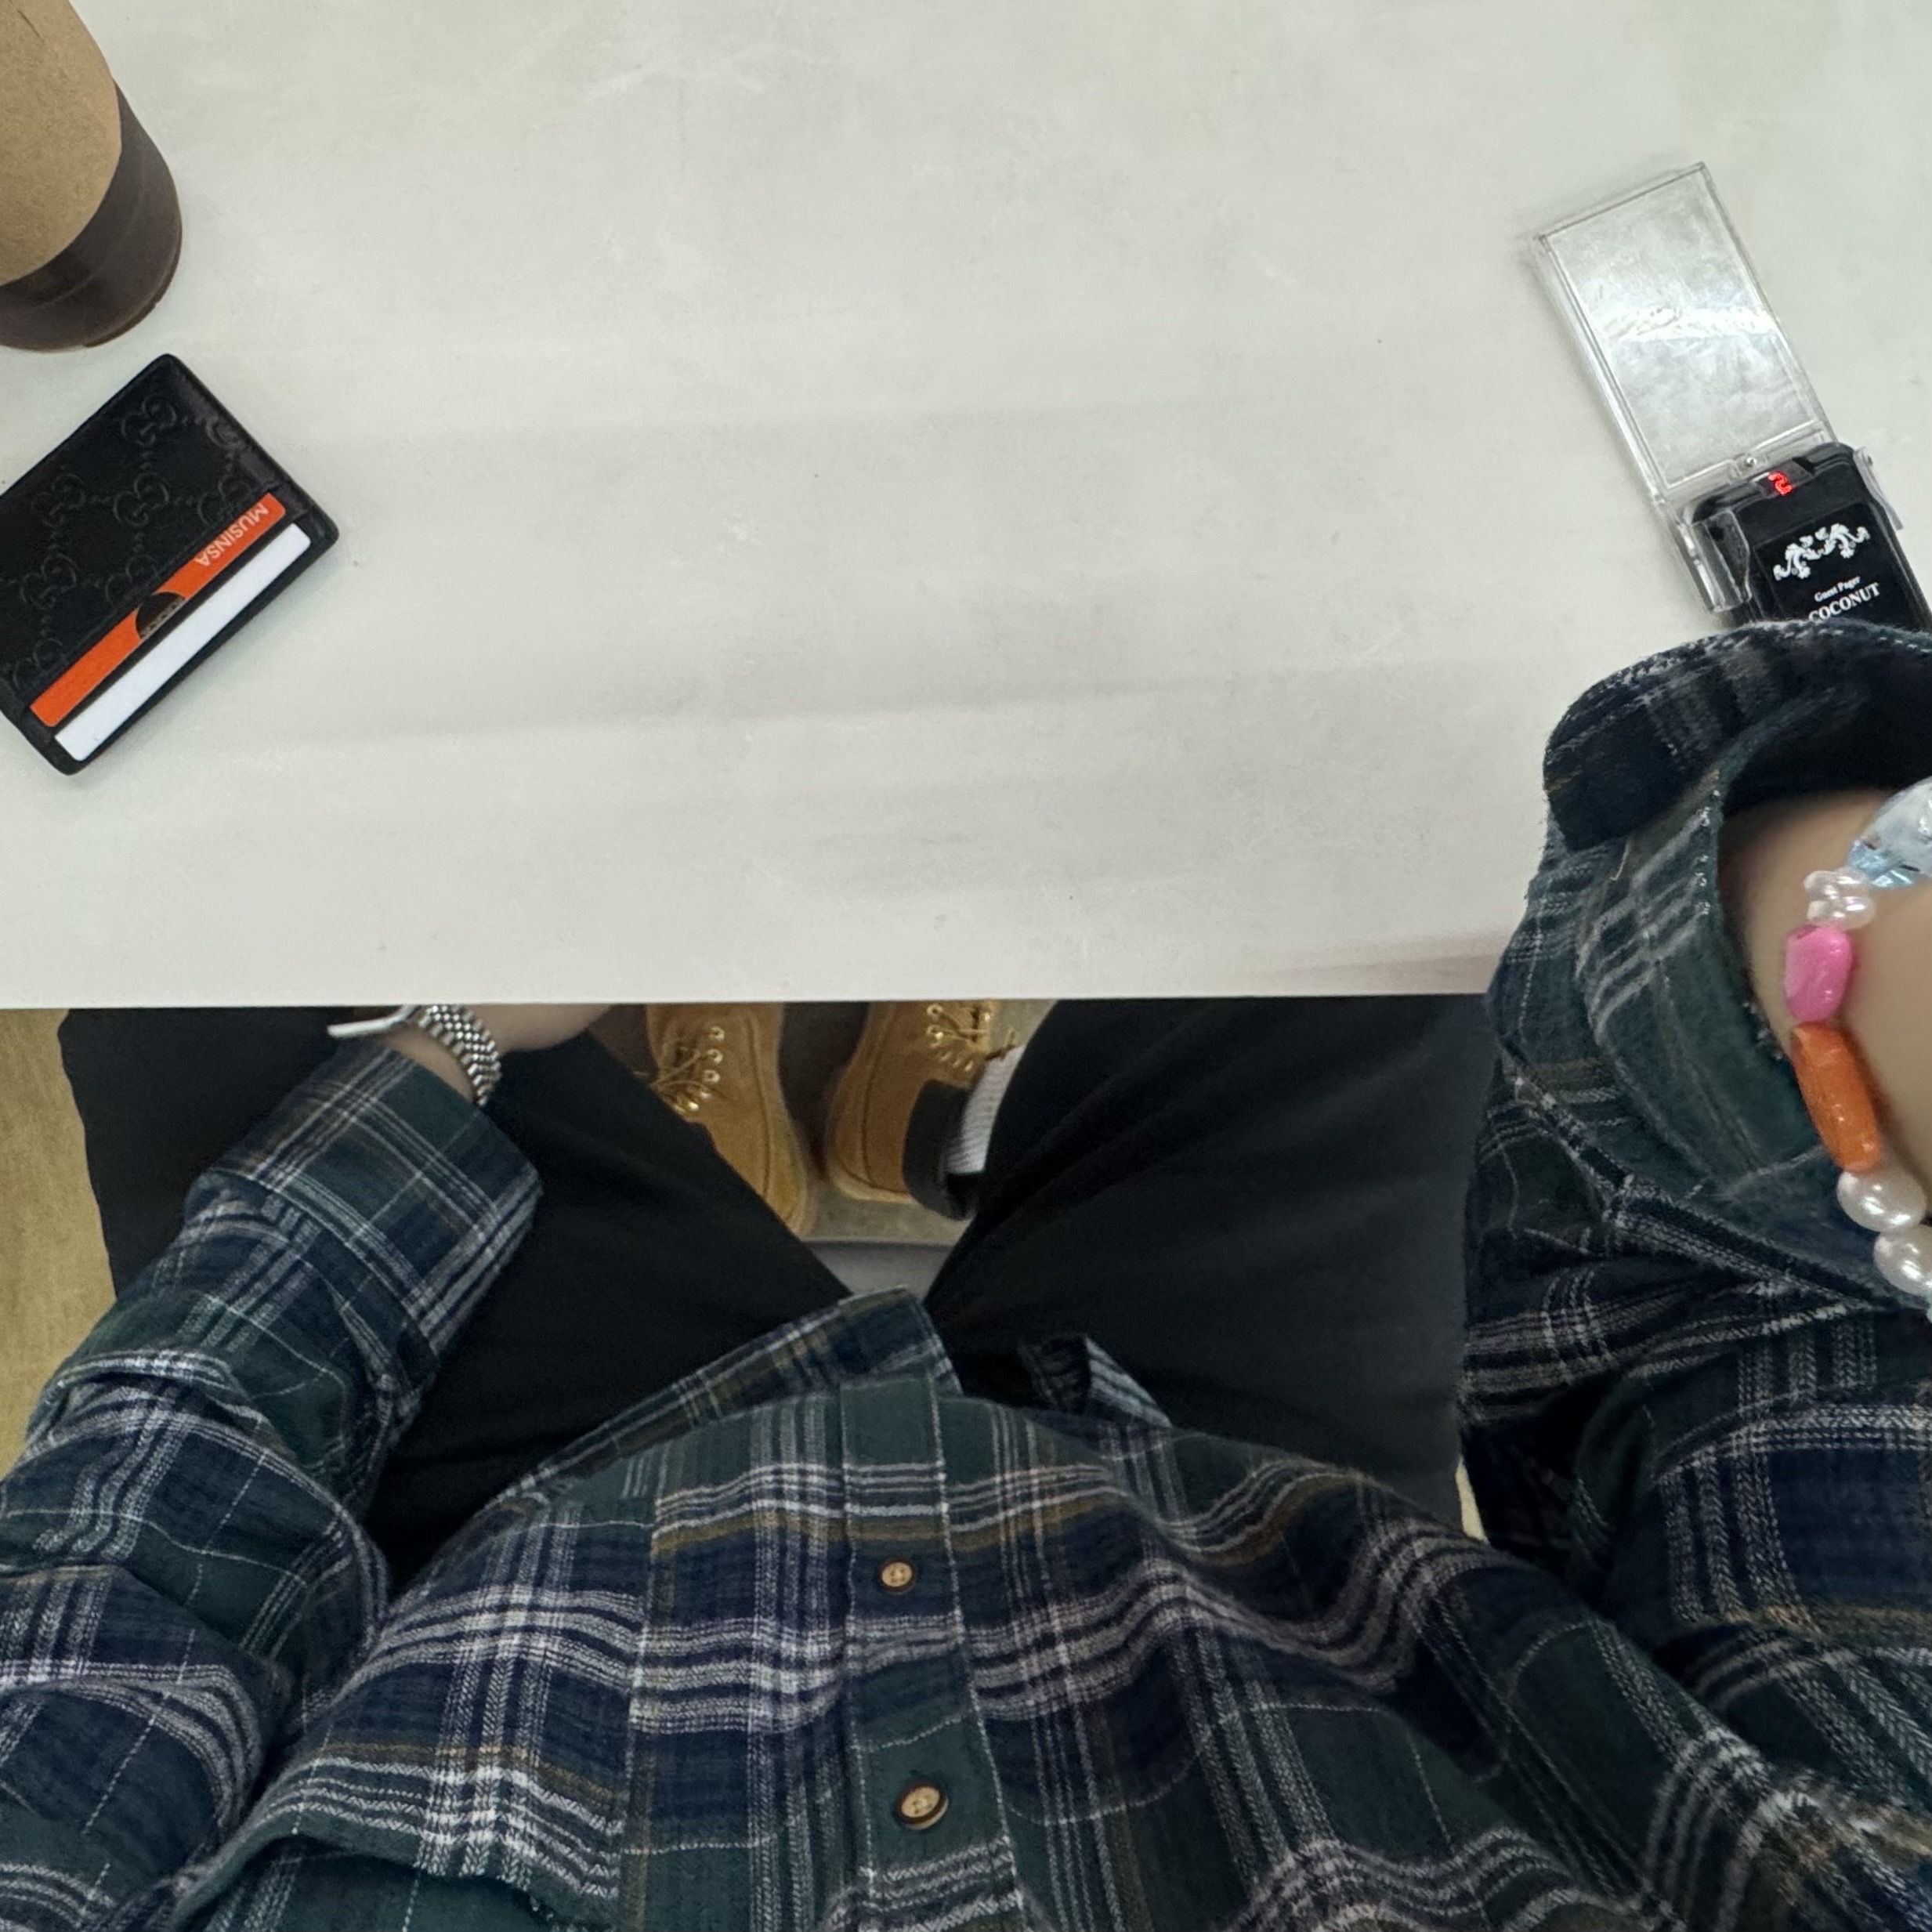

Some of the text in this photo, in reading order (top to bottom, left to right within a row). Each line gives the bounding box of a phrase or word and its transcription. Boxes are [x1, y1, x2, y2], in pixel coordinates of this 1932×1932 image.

[1767, 472, 1793, 495] 2
[196, 502, 269, 566] MUSINSA
[1808, 582, 1880, 624] COCONUT
